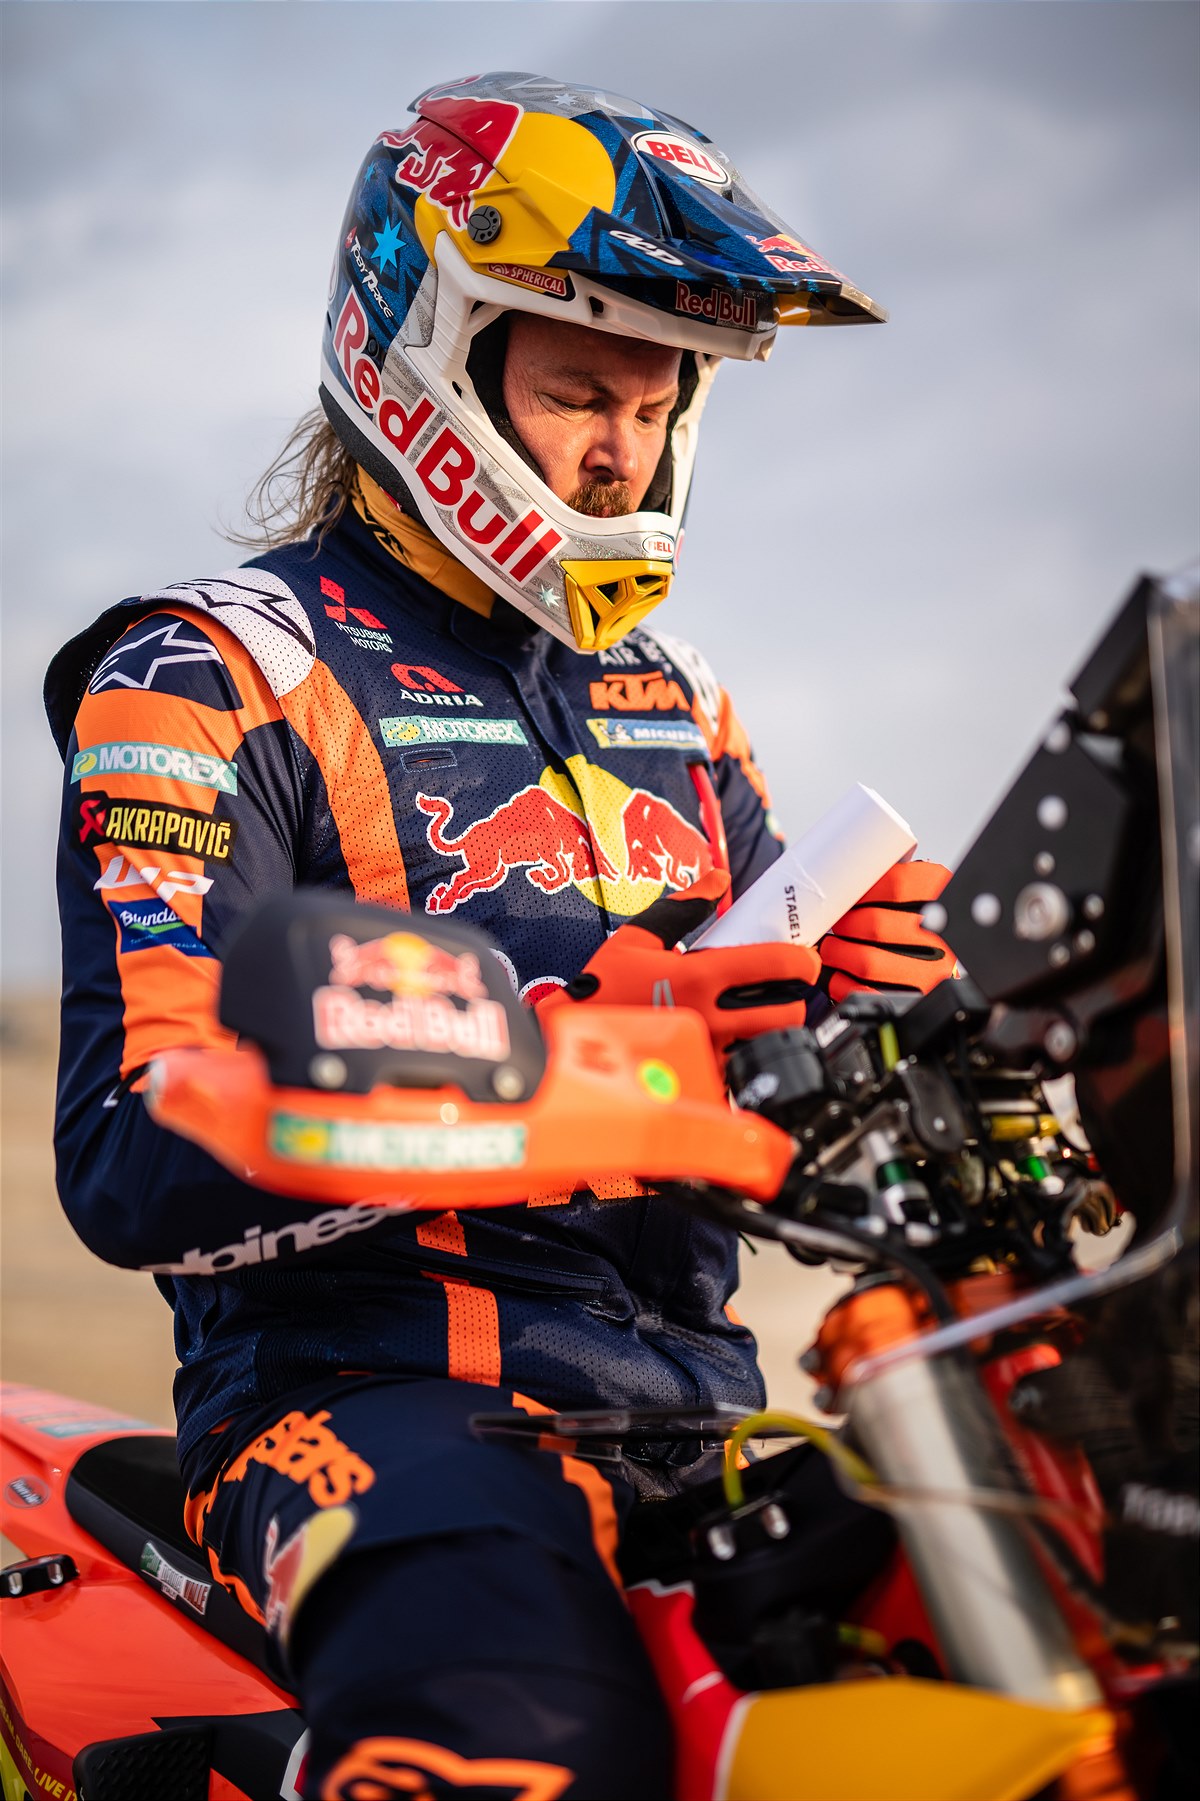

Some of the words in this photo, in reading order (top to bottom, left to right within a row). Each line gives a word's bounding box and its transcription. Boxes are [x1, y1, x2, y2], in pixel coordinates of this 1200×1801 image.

[645, 139, 722, 178] BELL
[511, 266, 562, 293] SPHERICAL
[764, 255, 827, 272] Red
[675, 281, 718, 319] Red
[718, 291, 757, 328] Bull
[333, 287, 437, 456] Red
[415, 427, 563, 583] Bull
[350, 636, 393, 653] MOTORS
[400, 689, 484, 707] ADRIA
[589, 670, 692, 712] KTM
[419, 718, 524, 741] MOTOREX
[100, 745, 231, 788] MOTOREX
[784, 885, 801, 931] STAGE
[34, 1767, 66, 1799] LIVE
